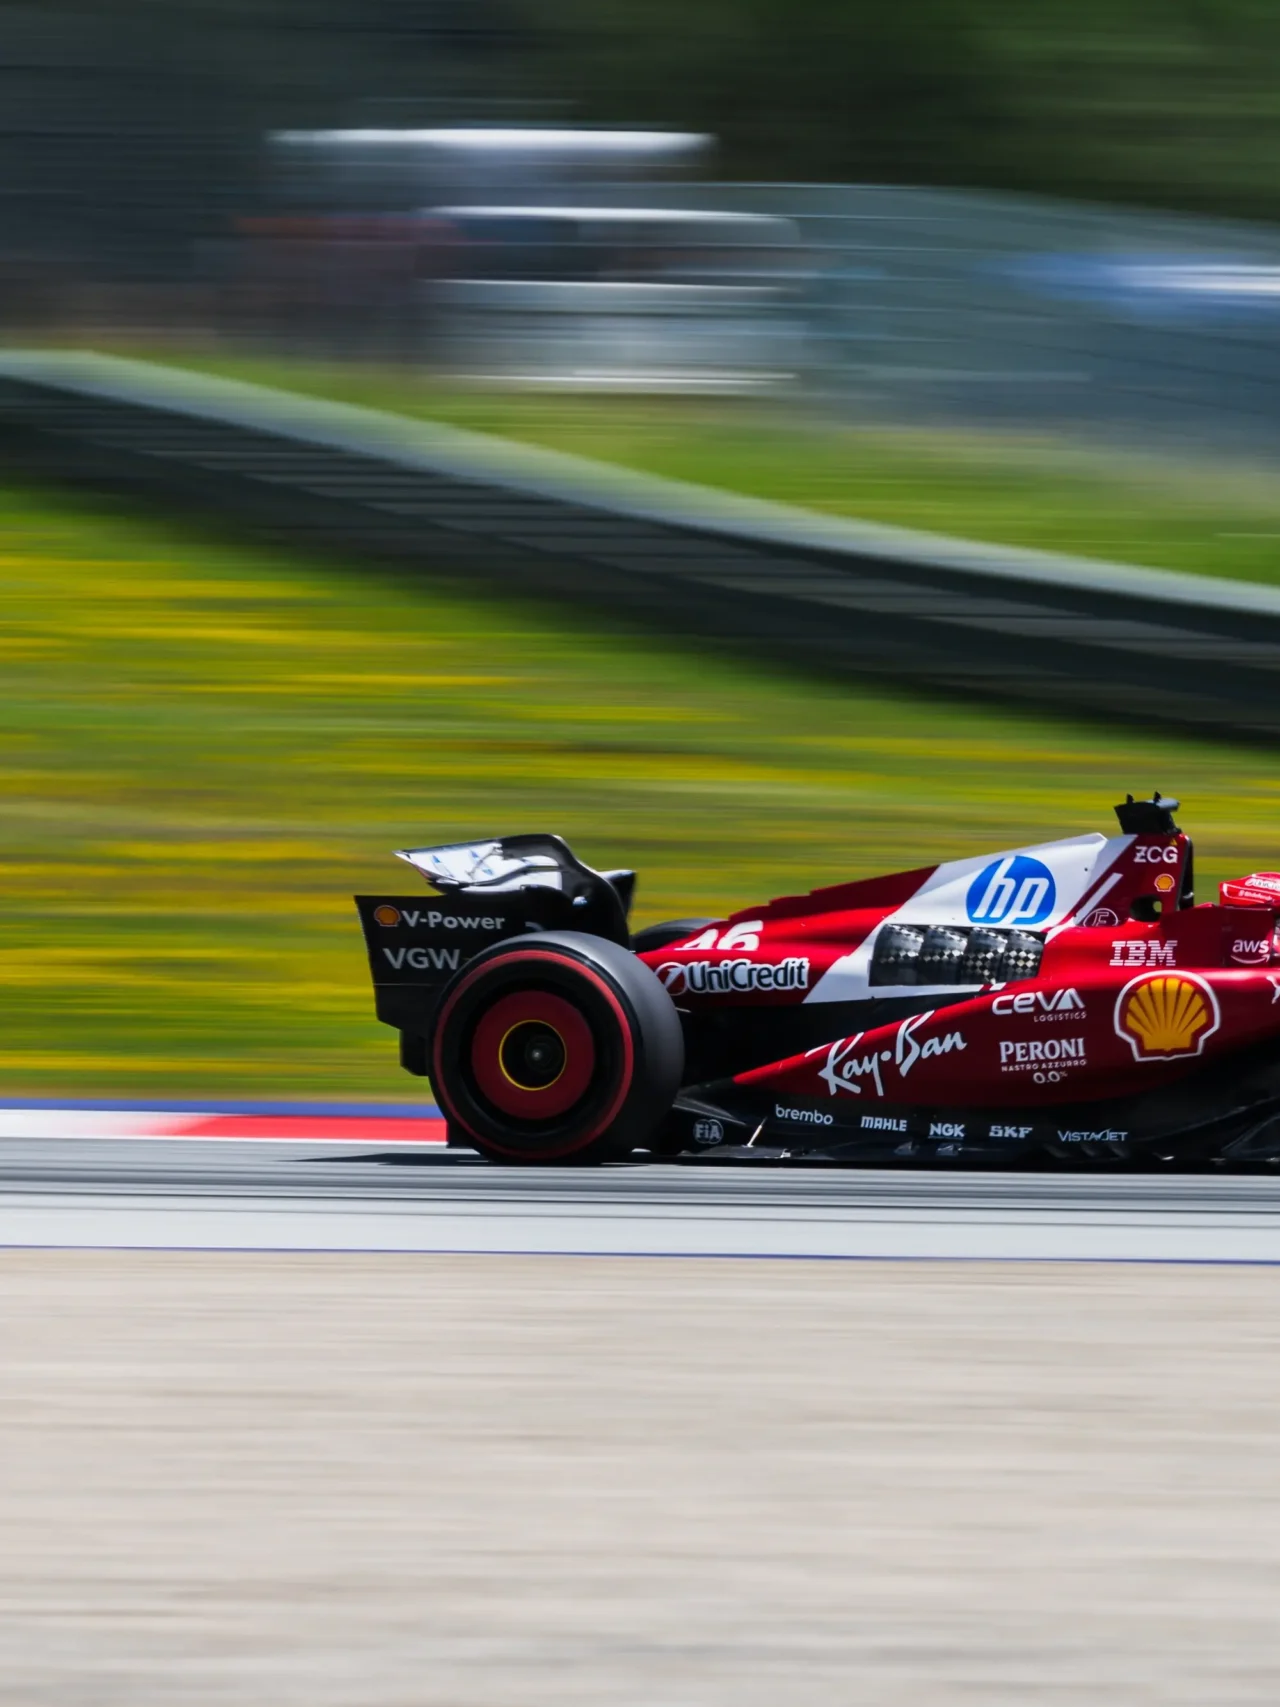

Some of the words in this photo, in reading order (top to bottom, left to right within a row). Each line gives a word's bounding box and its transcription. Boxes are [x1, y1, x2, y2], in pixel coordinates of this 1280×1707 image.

[1134, 846, 1179, 864] ZCG
[972, 855, 1050, 925] hp
[402, 910, 505, 930] V-Power
[1109, 940, 1178, 967] IBM
[1232, 939, 1270, 954] aws
[383, 947, 460, 970] VGW
[687, 959, 808, 992] UniCredit
[1033, 1012, 1087, 1023] LOGISTICS
[999, 1037, 1086, 1064] PERONI
[1001, 1062, 1039, 1072] NASTRO
[1041, 1058, 1087, 1070] AZZURRO
[775, 1104, 834, 1125] brembo
[861, 1116, 907, 1132] MAHLE
[929, 1123, 965, 1137] NGK
[989, 1125, 1033, 1138] SKF
